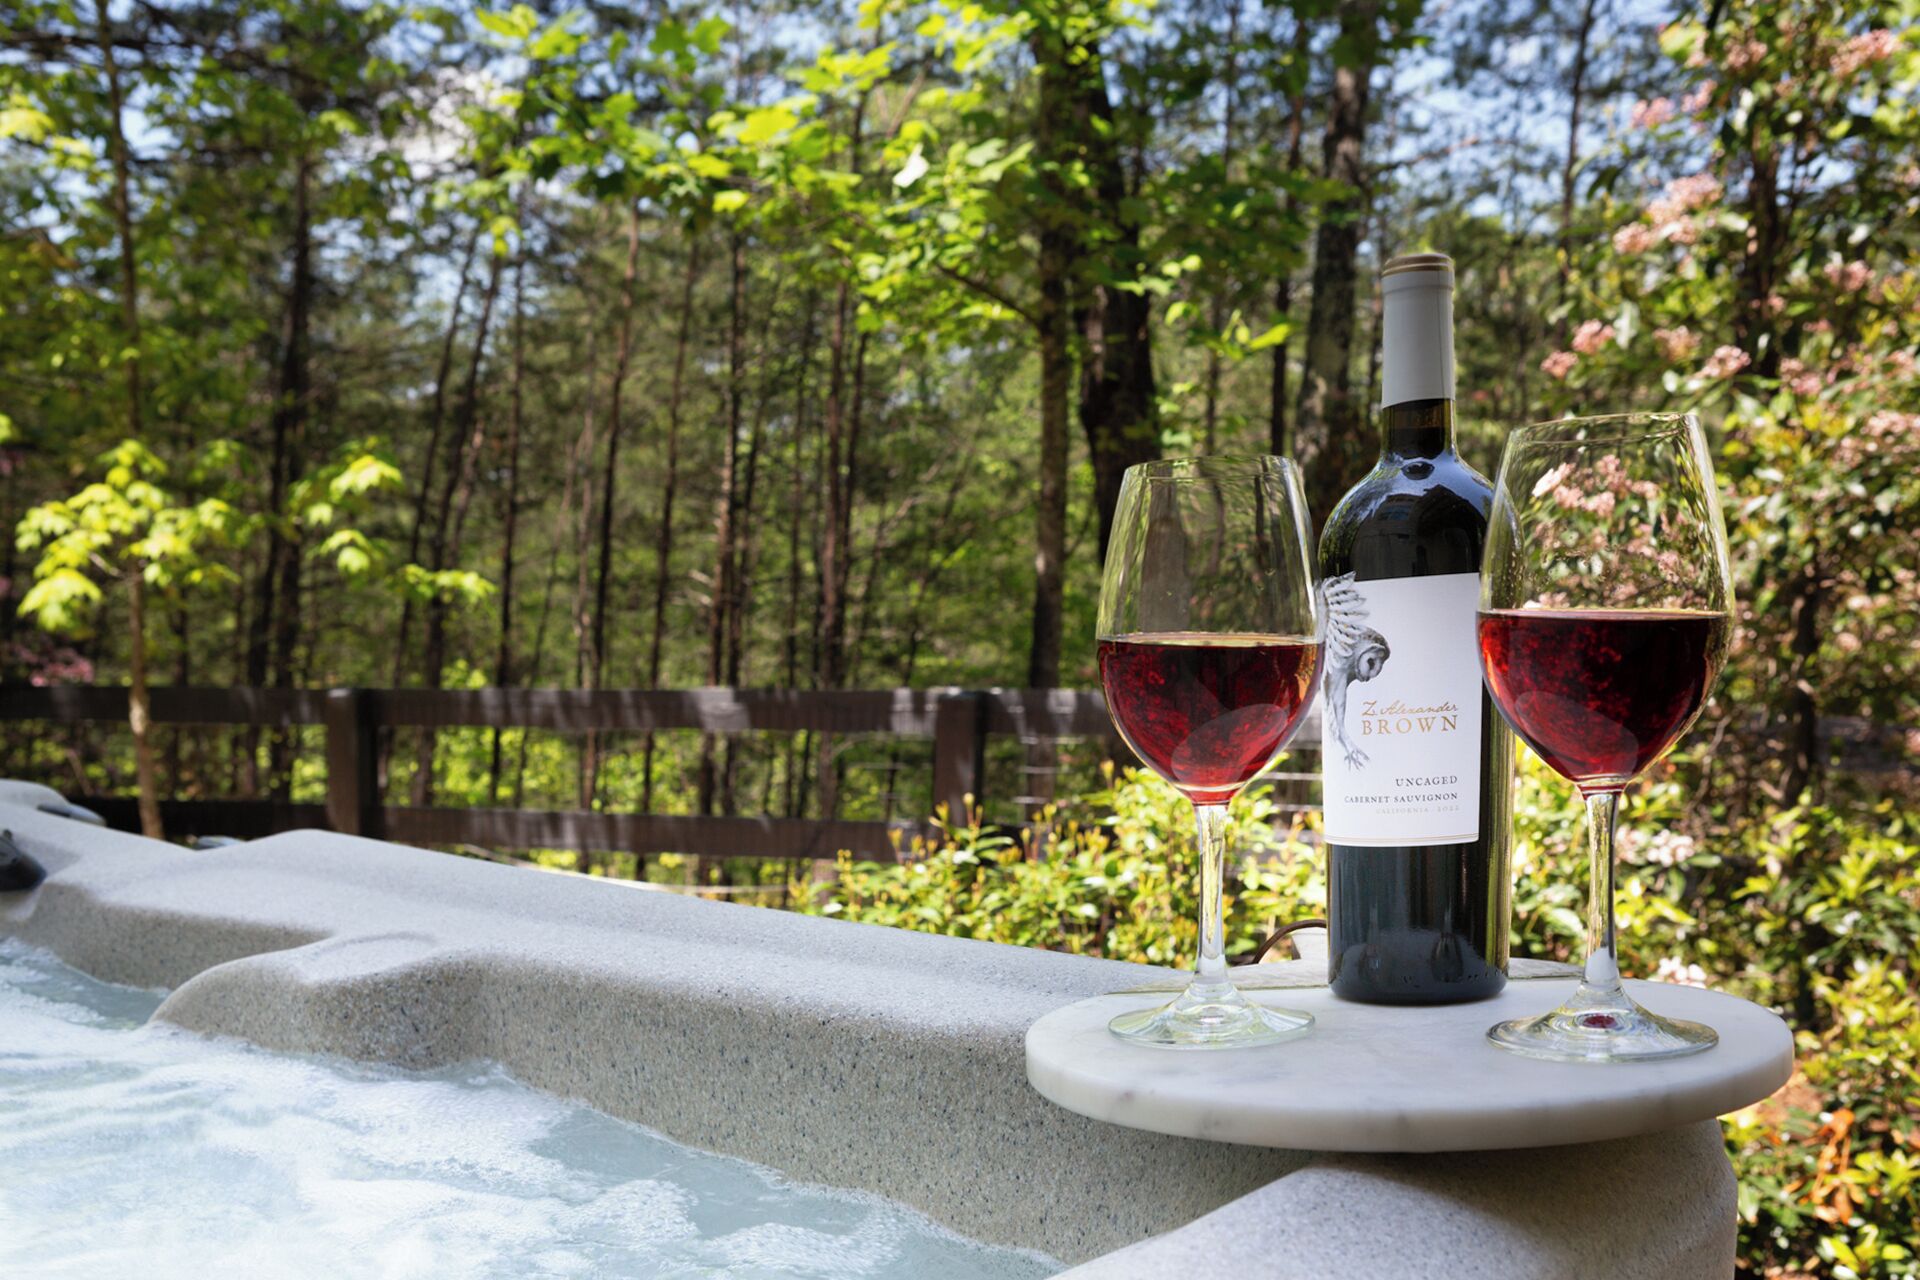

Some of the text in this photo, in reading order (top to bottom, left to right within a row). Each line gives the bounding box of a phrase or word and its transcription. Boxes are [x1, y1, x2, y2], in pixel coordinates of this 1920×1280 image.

[1379, 699, 1459, 715] Alexander
[1361, 714, 1459, 736] BROWN
[1395, 775, 1458, 788] UNCAGED
[1343, 792, 1458, 804] CABERNET SAUVIGNON
